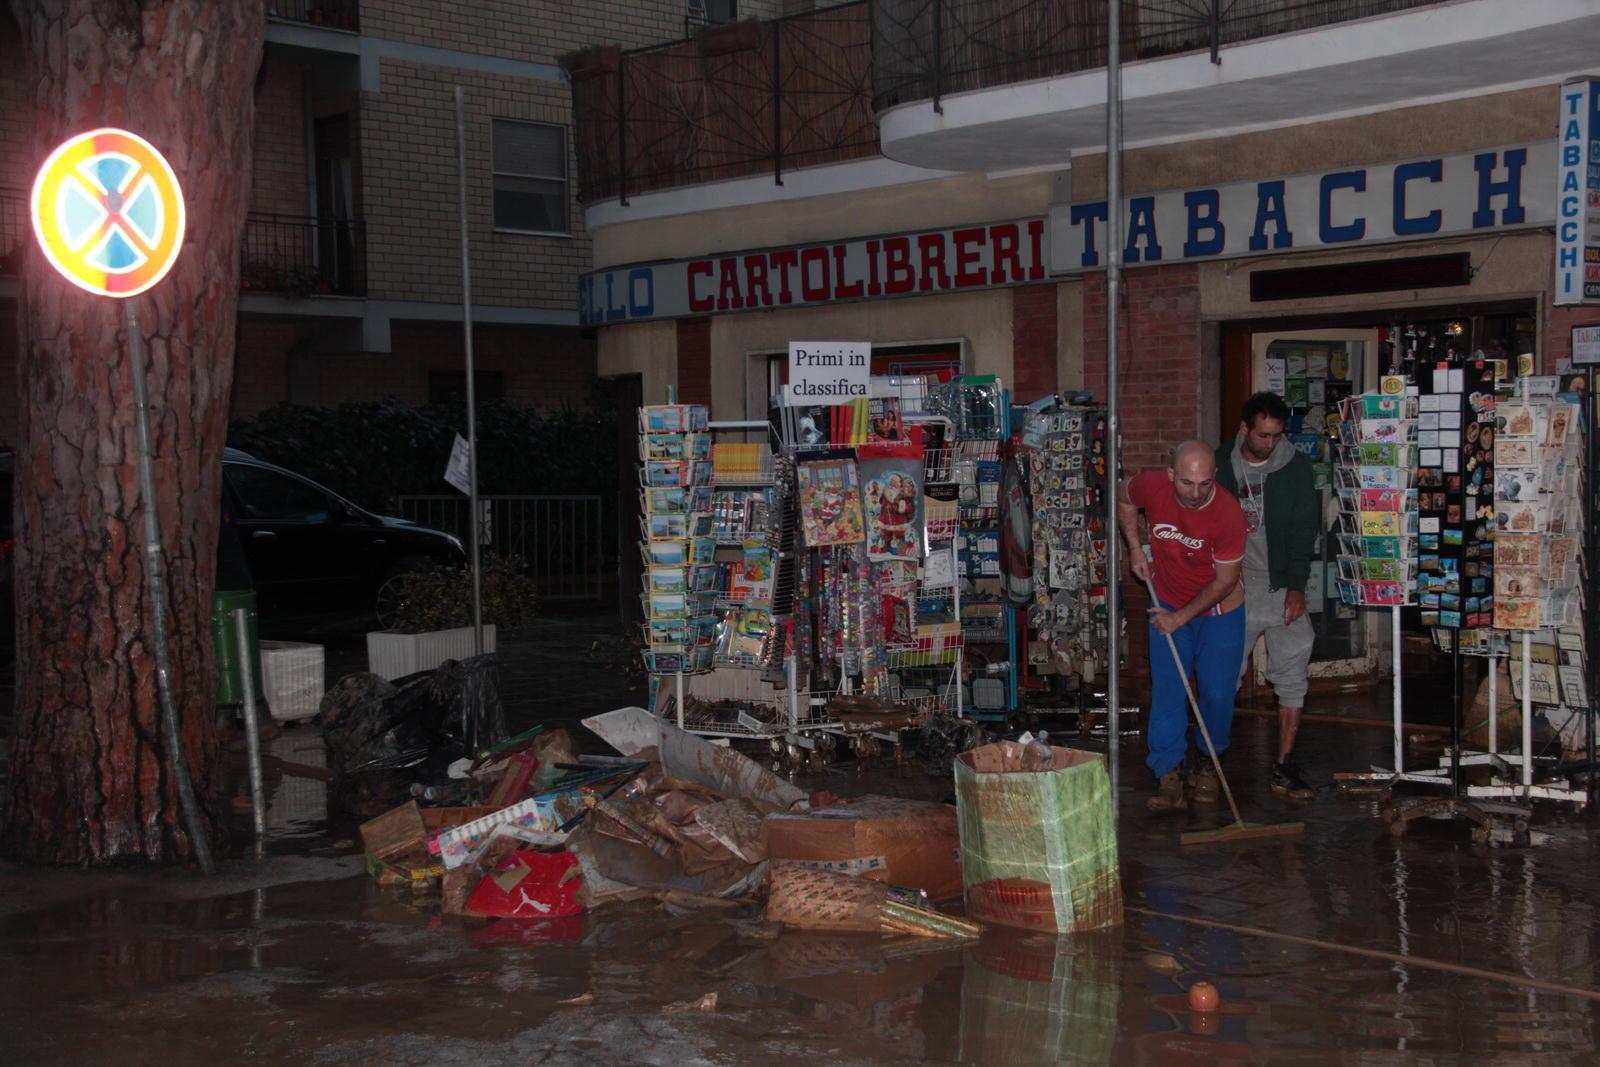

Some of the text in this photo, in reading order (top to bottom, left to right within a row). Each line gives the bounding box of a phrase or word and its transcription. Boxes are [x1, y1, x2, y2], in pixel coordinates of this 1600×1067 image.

[1070, 148, 1527, 266] TABACCH
[1560, 93, 1583, 293] TABACCHI
[687, 219, 1045, 313] CARTOLIBRERI
[793, 378, 867, 396] classifica
[795, 349, 866, 367] Primi in
